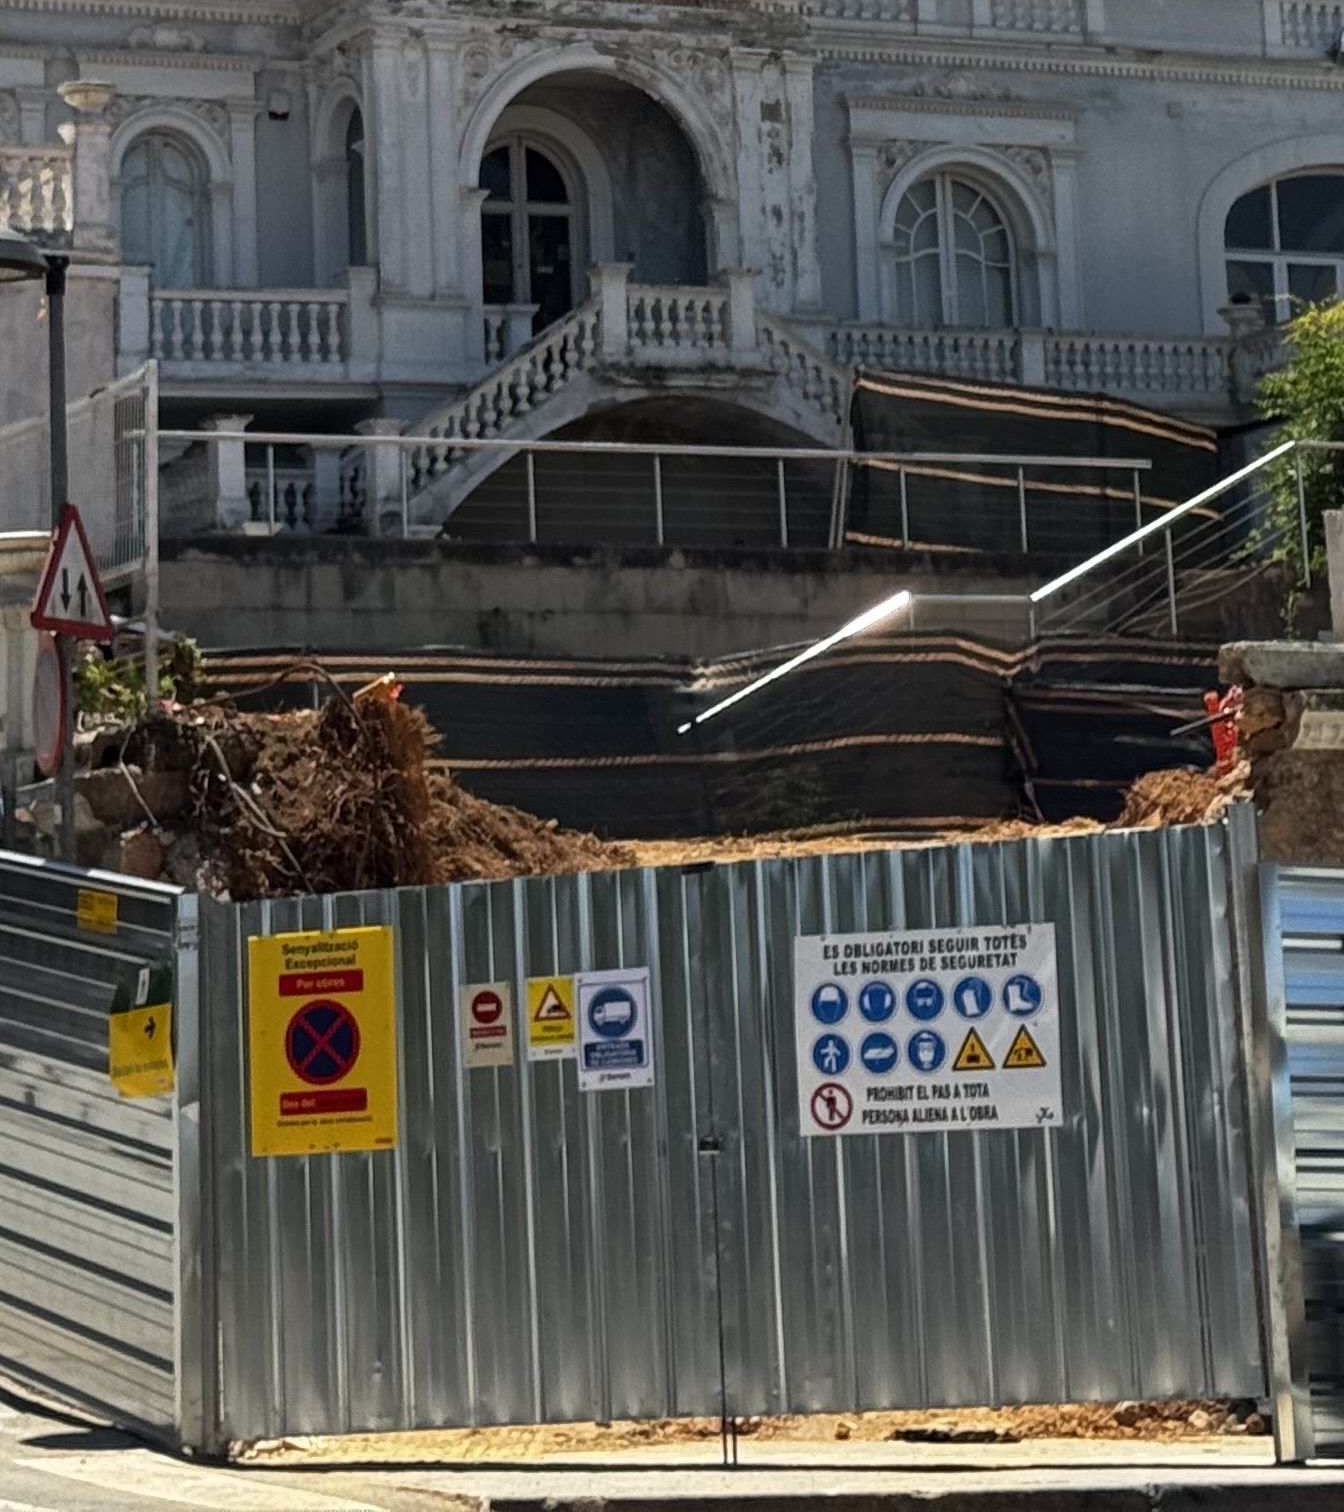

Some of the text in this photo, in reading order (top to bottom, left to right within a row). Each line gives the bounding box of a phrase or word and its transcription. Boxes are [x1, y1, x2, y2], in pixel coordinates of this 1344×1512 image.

[282, 939, 359, 956] Senyalització
[844, 940, 924, 958] OBLIGATORI
[928, 937, 980, 954] SEGUIR
[285, 953, 356, 970] Excepcional
[833, 953, 1018, 976] LES NORMES DE SEGURETAT
[866, 1082, 990, 1102] PROHIBIT EL PAS A TOTA
[862, 1108, 910, 1125] PERSONA
[912, 1106, 949, 1123] ALIENA
[951, 1106, 960, 1122] A
